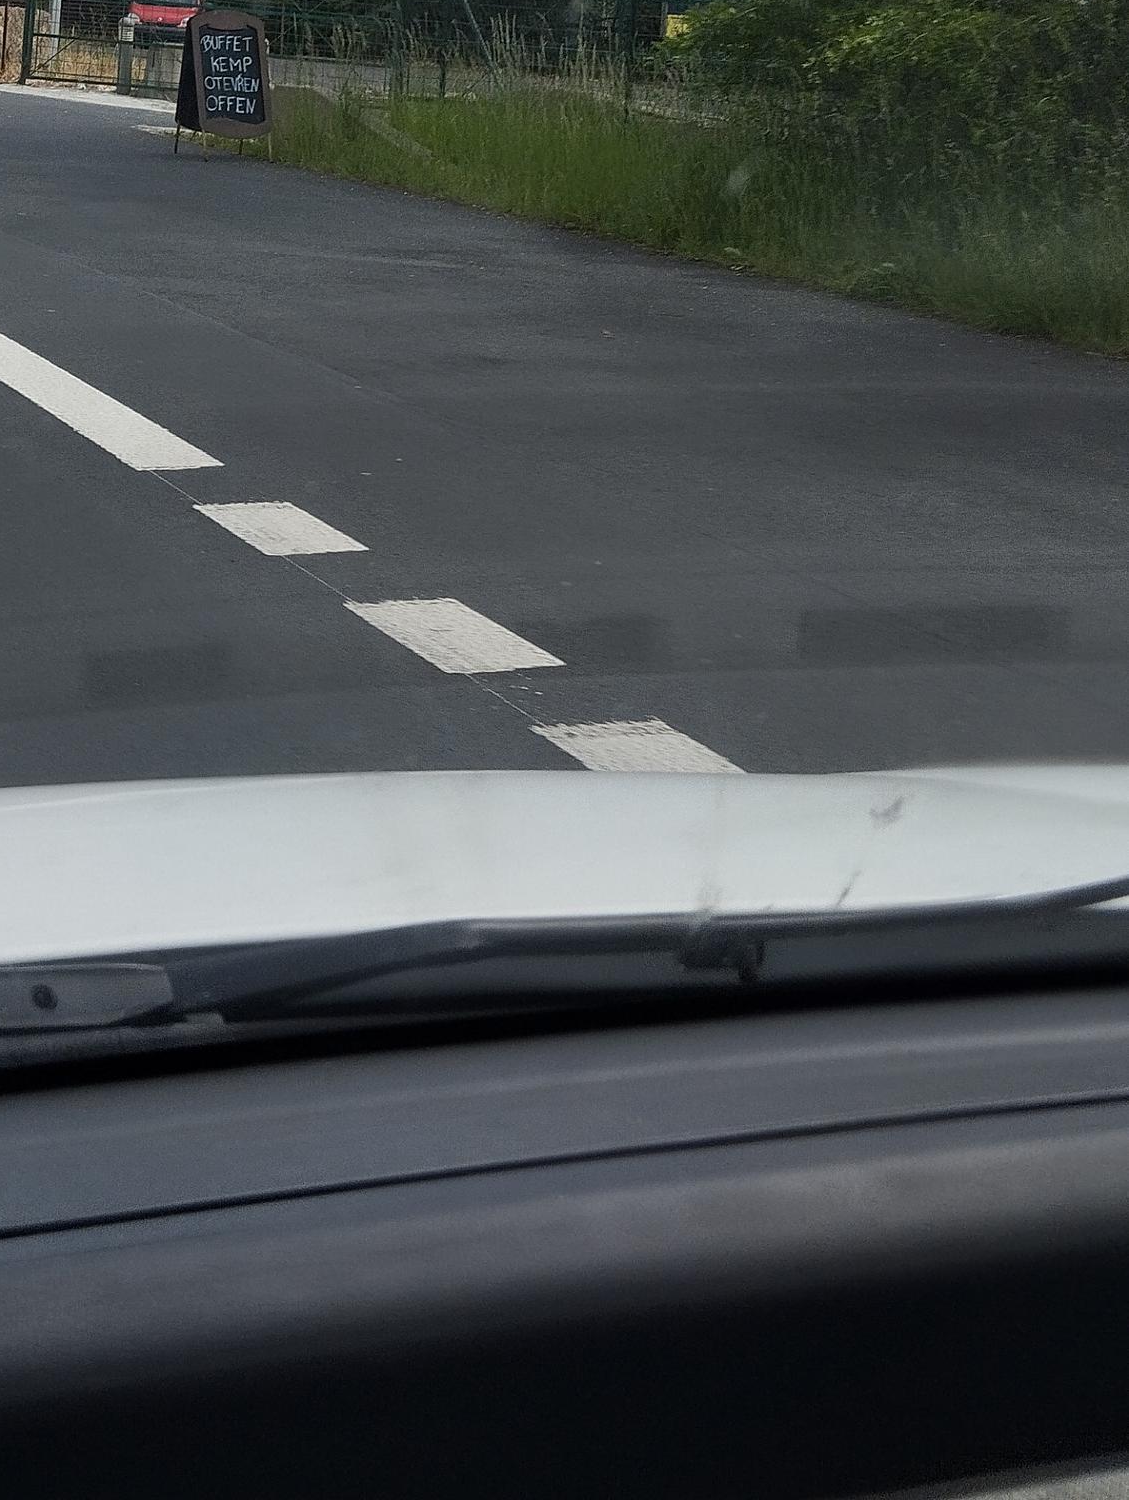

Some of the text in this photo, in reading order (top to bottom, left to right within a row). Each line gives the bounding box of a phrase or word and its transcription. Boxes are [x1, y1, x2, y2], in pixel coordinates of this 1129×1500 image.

[200, 35, 253, 52] BUFFET
[211, 56, 253, 73] KEMP
[206, 95, 256, 114] OFFEN
